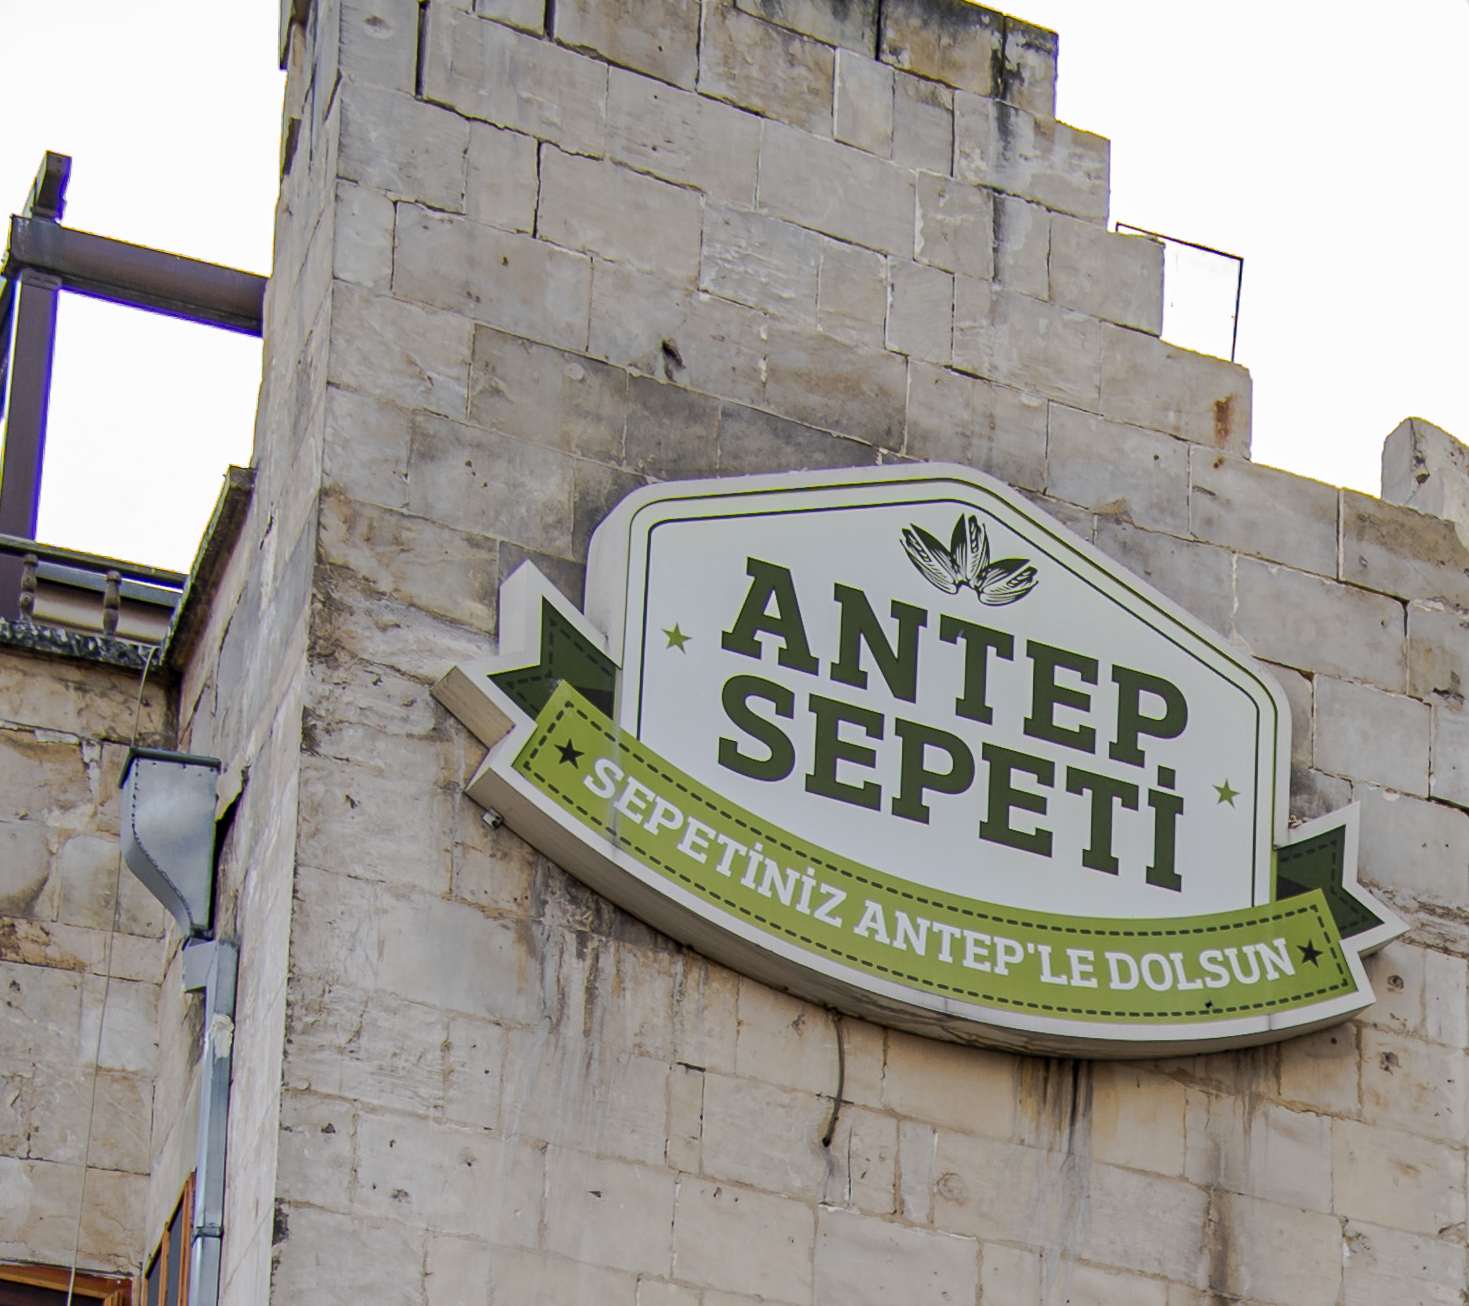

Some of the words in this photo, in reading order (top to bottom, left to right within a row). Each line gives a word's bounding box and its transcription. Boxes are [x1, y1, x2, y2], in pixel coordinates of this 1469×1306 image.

[720, 556, 1190, 769] ANTEP
[583, 757, 849, 929] SEPETİNİZ
[852, 899, 1099, 989] ANTEP'LE
[1104, 937, 1297, 993] DOLSUN
[717, 674, 1185, 894] SEPETİ
